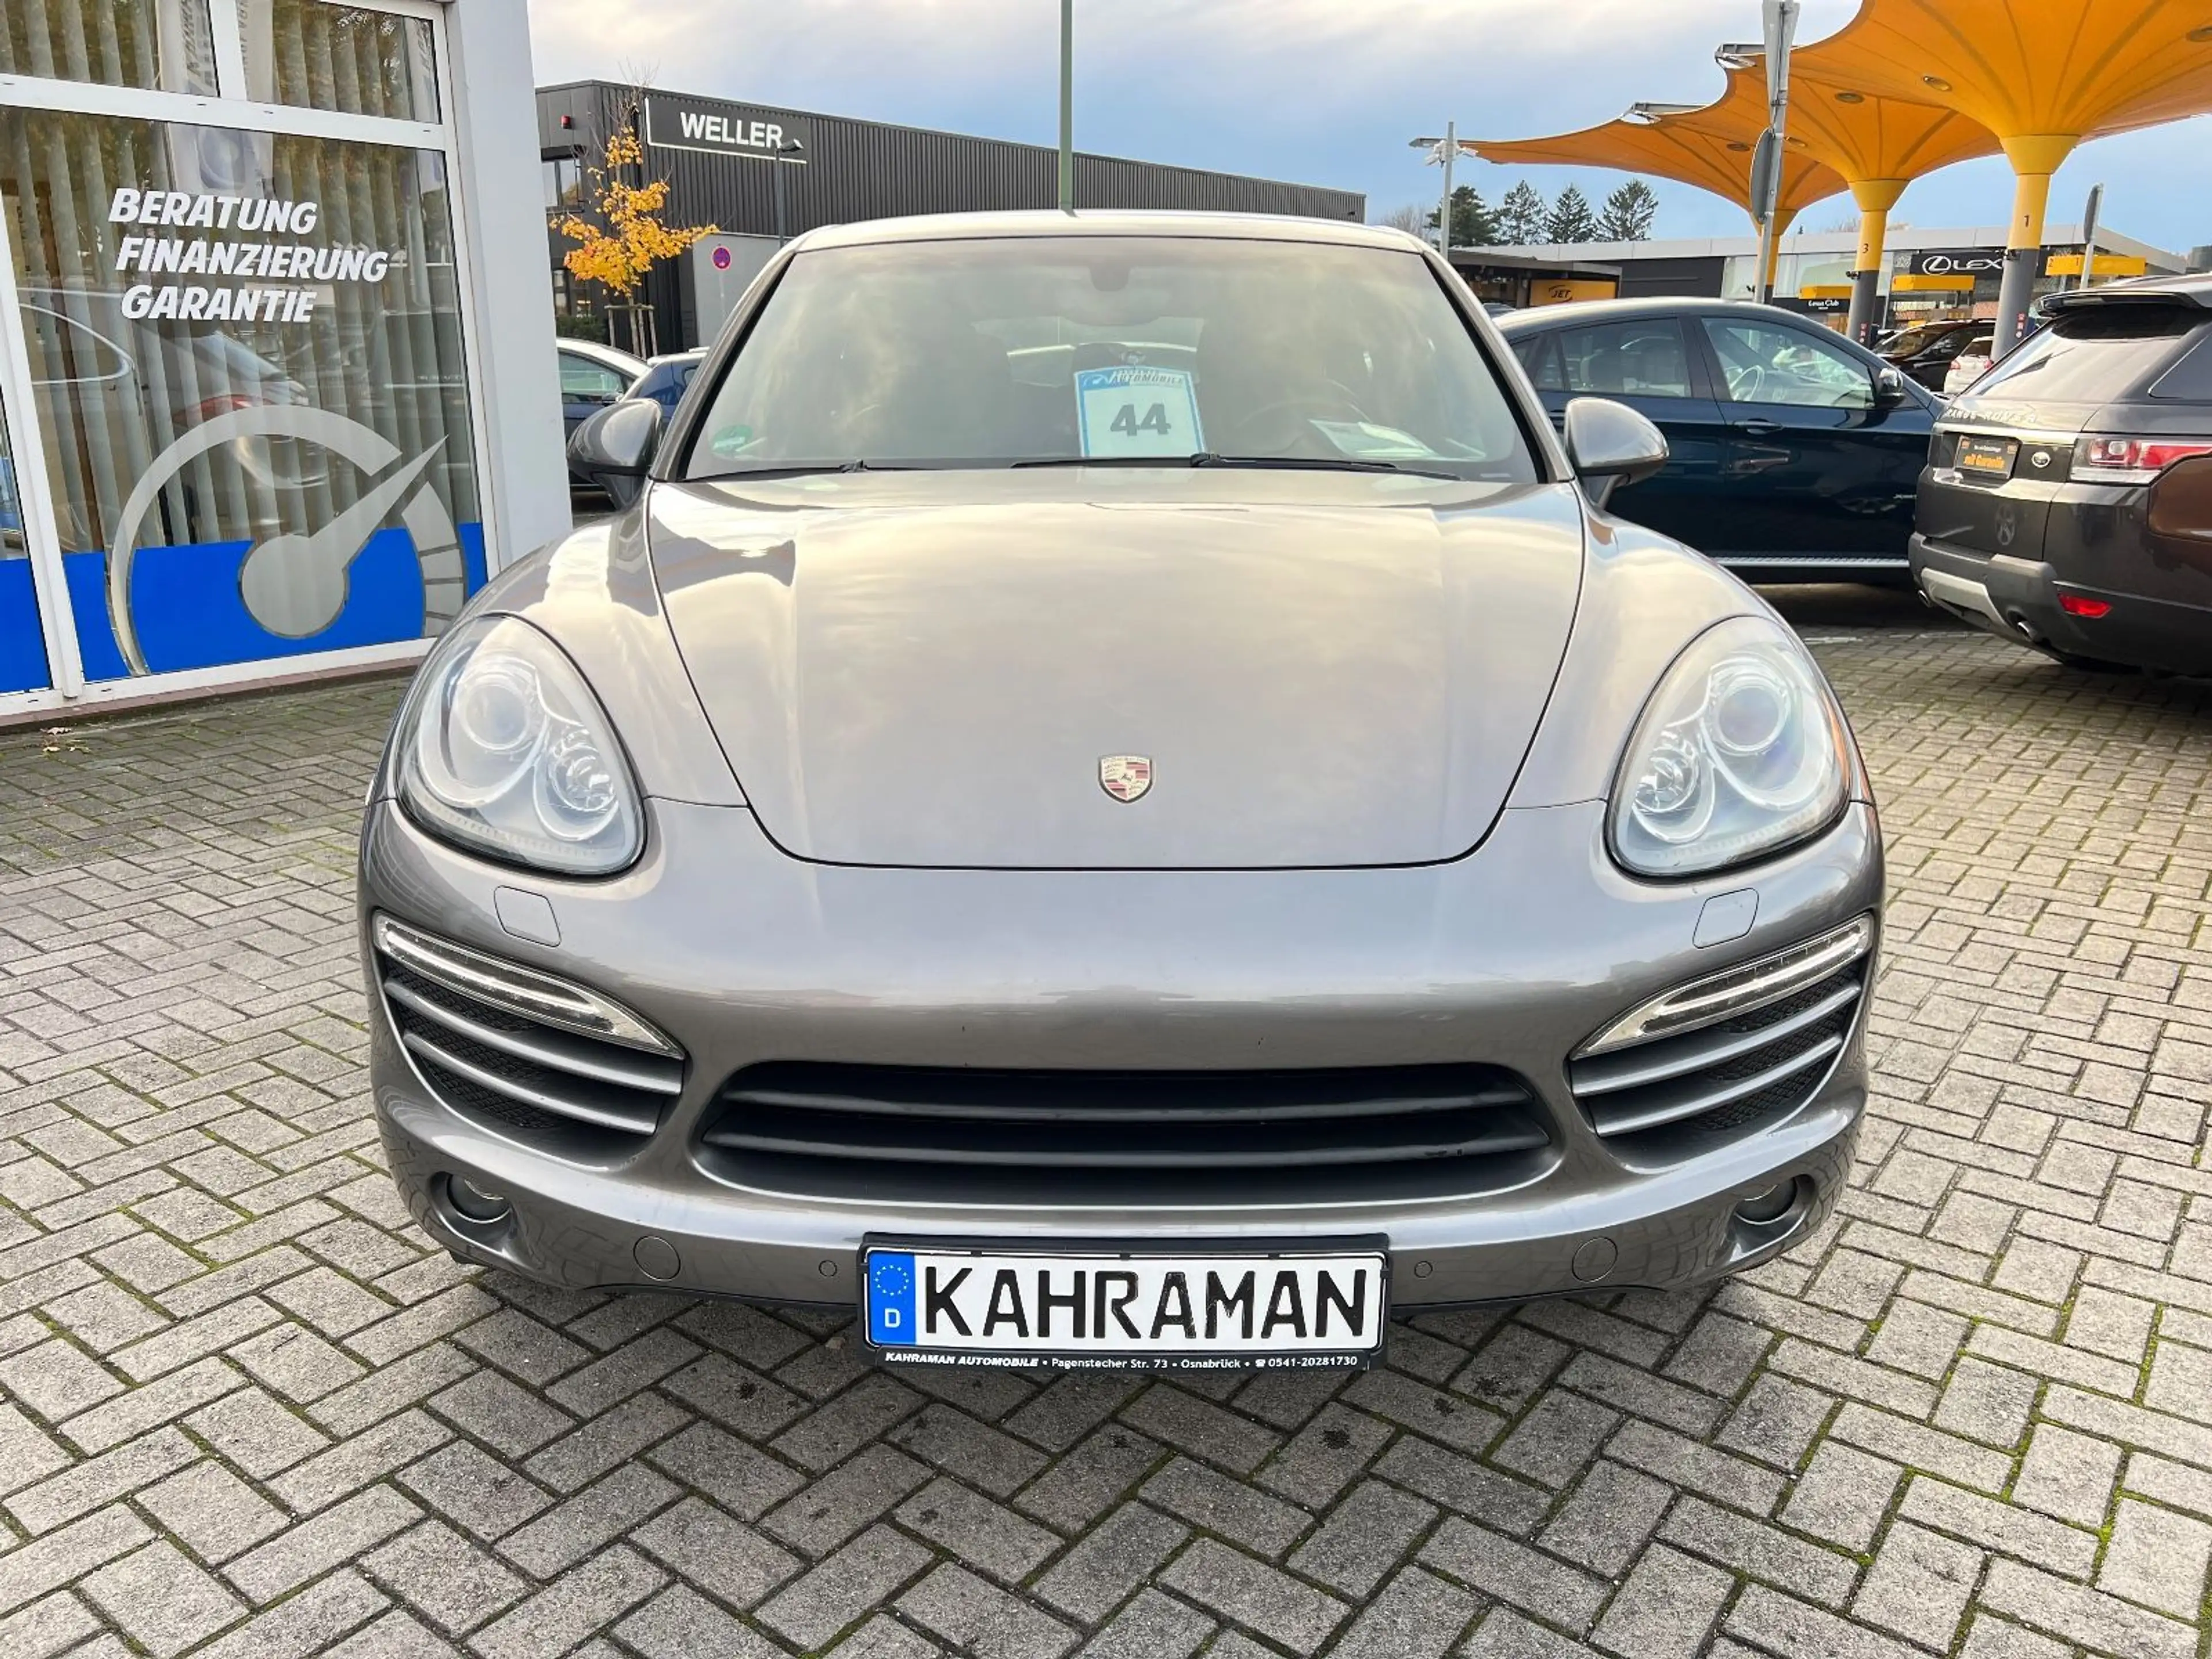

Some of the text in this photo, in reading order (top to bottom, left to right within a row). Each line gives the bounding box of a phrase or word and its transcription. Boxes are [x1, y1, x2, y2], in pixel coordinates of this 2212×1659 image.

[680, 112, 782, 149] WELLER
[108, 188, 318, 235] BERATUNG
[2024, 215, 2029, 228] 1
[116, 237, 389, 282] FINANZIERUNG
[1862, 243, 1869, 253] 3
[1953, 258, 2003, 270] LEX
[120, 285, 318, 323] GARANTIE
[1551, 290, 1571, 298] JET
[1109, 403, 1172, 436] 44
[925, 1266, 1366, 1338] KAHRAMAN
[884, 1308, 901, 1328] D
[885, 1352, 1358, 1369] KAHRAMAN AUTOMOBILE Pagenstecher Str. 73 Osnabrück 0541-20281730
